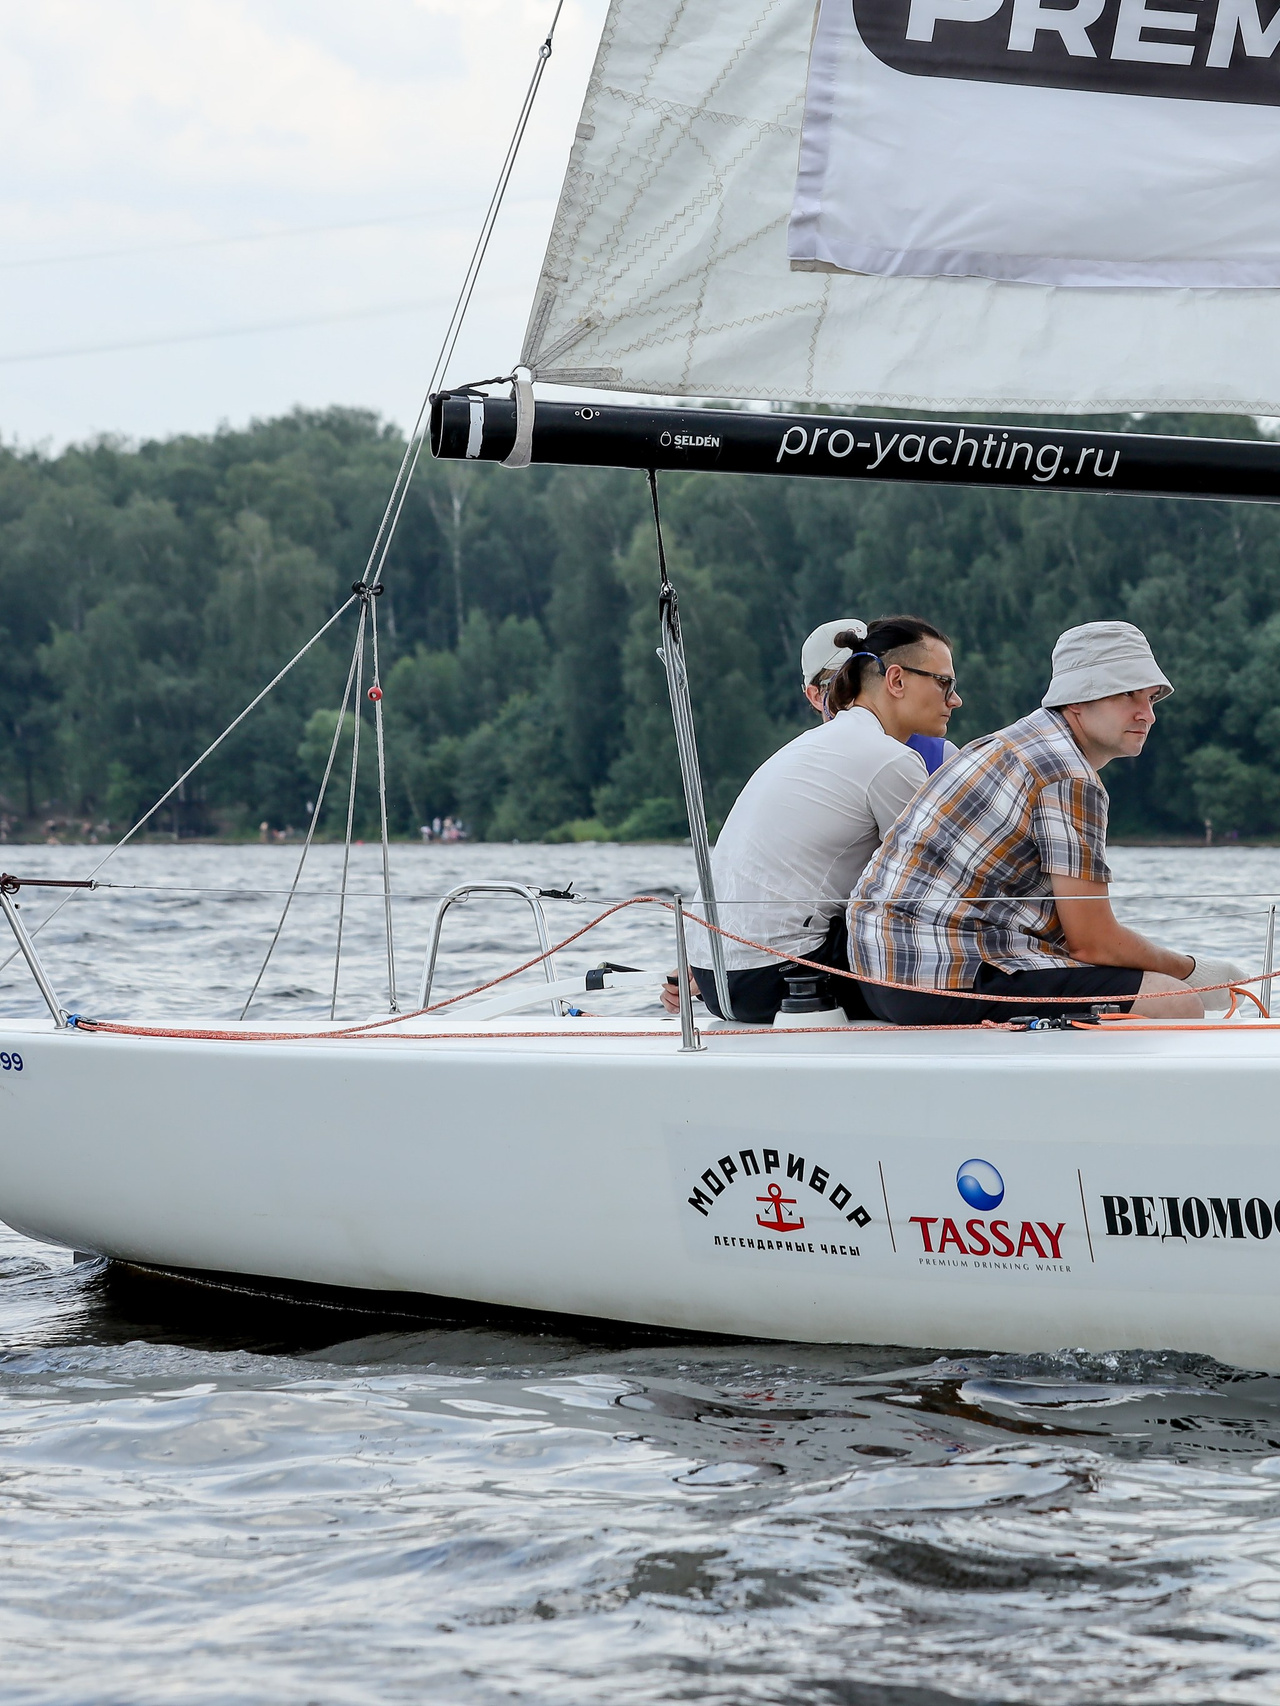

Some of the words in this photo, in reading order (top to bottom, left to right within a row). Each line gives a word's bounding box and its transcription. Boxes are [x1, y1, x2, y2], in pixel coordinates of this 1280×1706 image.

[776, 425, 1121, 482] pro-yachting.ru
[687, 1148, 872, 1229] МОРПРИБОР
[714, 1235, 815, 1253] ЛЕГЕНДАРНЫЕ
[820, 1243, 861, 1257] ЧАСЫ
[908, 1216, 1067, 1260] TASSAY
[918, 1257, 969, 1268] PREMIUM
[973, 1260, 1030, 1271] DRINKING
[1035, 1264, 1072, 1273] WATER
